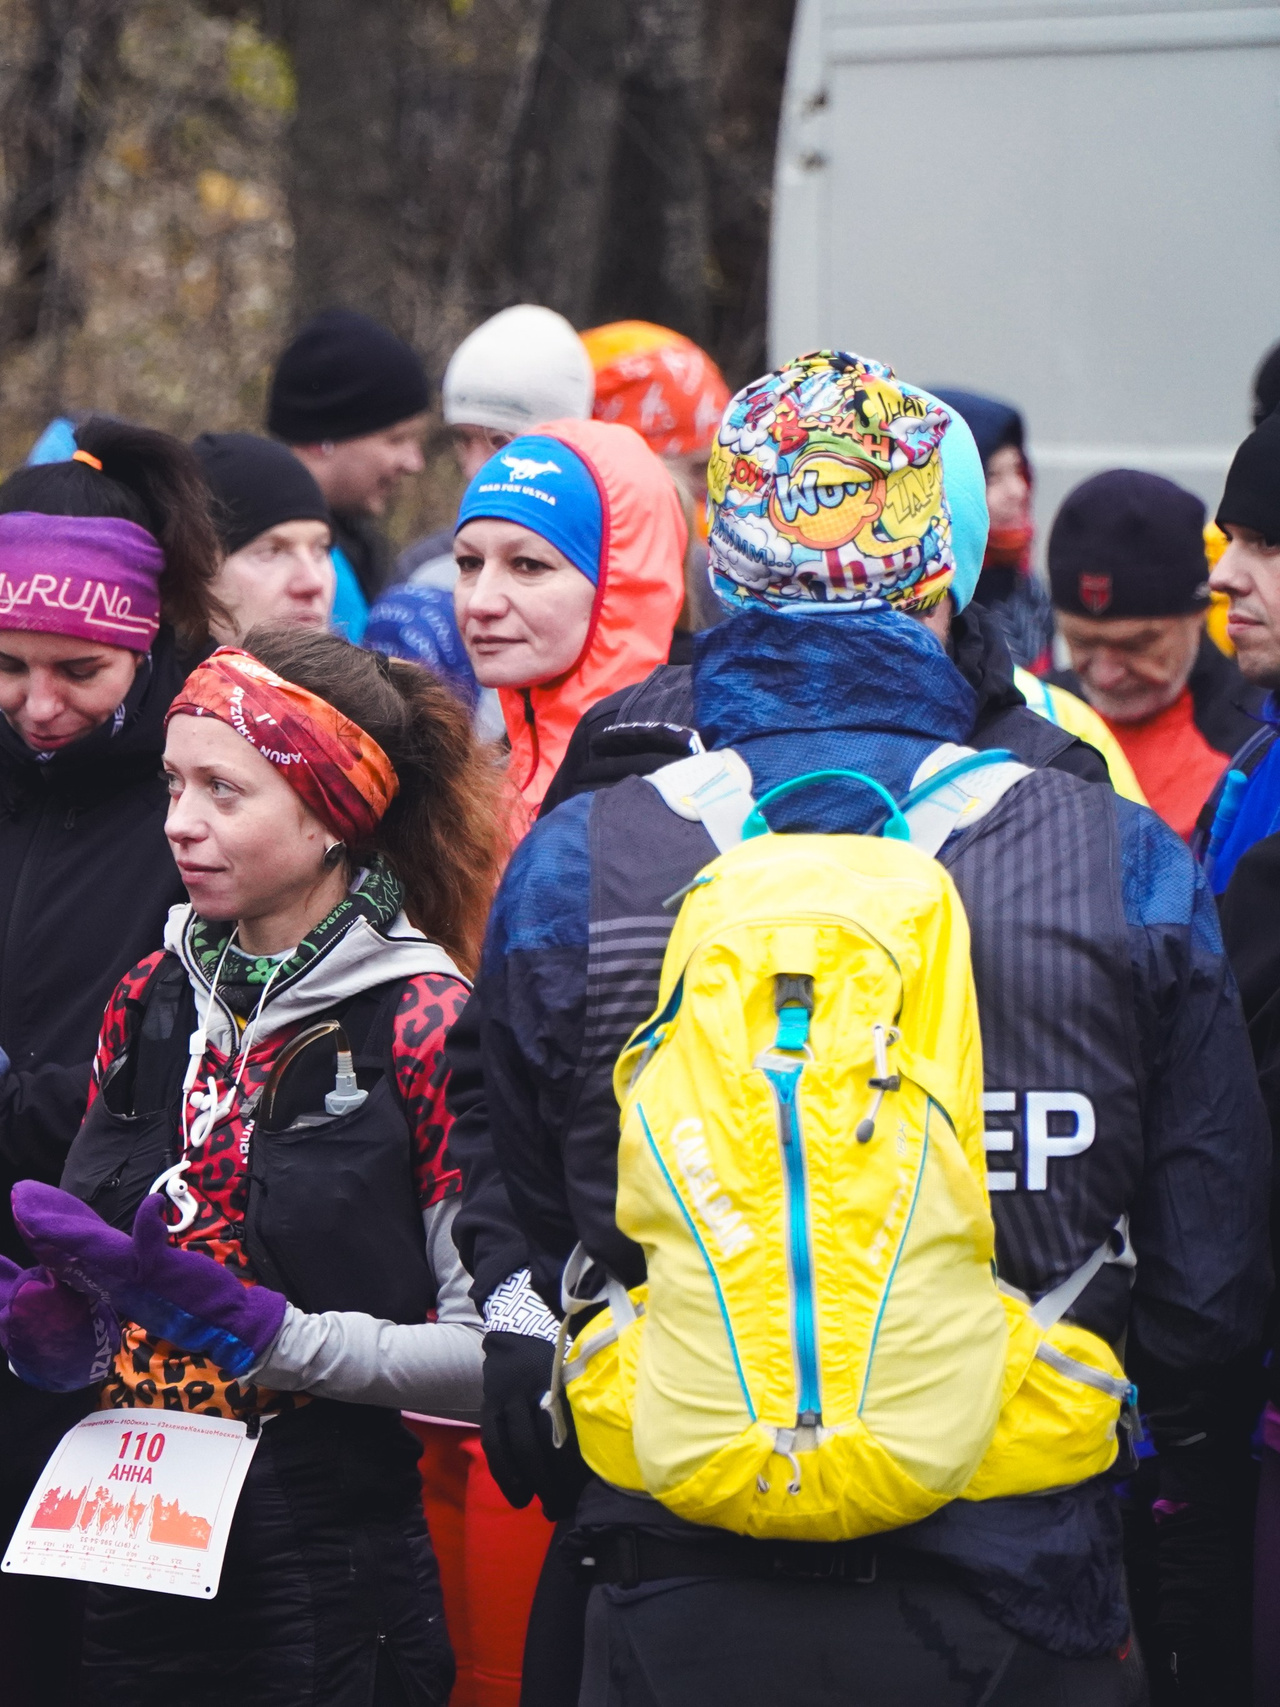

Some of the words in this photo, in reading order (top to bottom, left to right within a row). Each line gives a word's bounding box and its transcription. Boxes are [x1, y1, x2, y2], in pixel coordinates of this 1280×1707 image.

[797, 411, 891, 463] CRAH
[775, 469, 872, 523] WO
[260, 744, 304, 765] ARUN
[119, 1430, 166, 1463] 110
[108, 1463, 152, 1485] АННА
